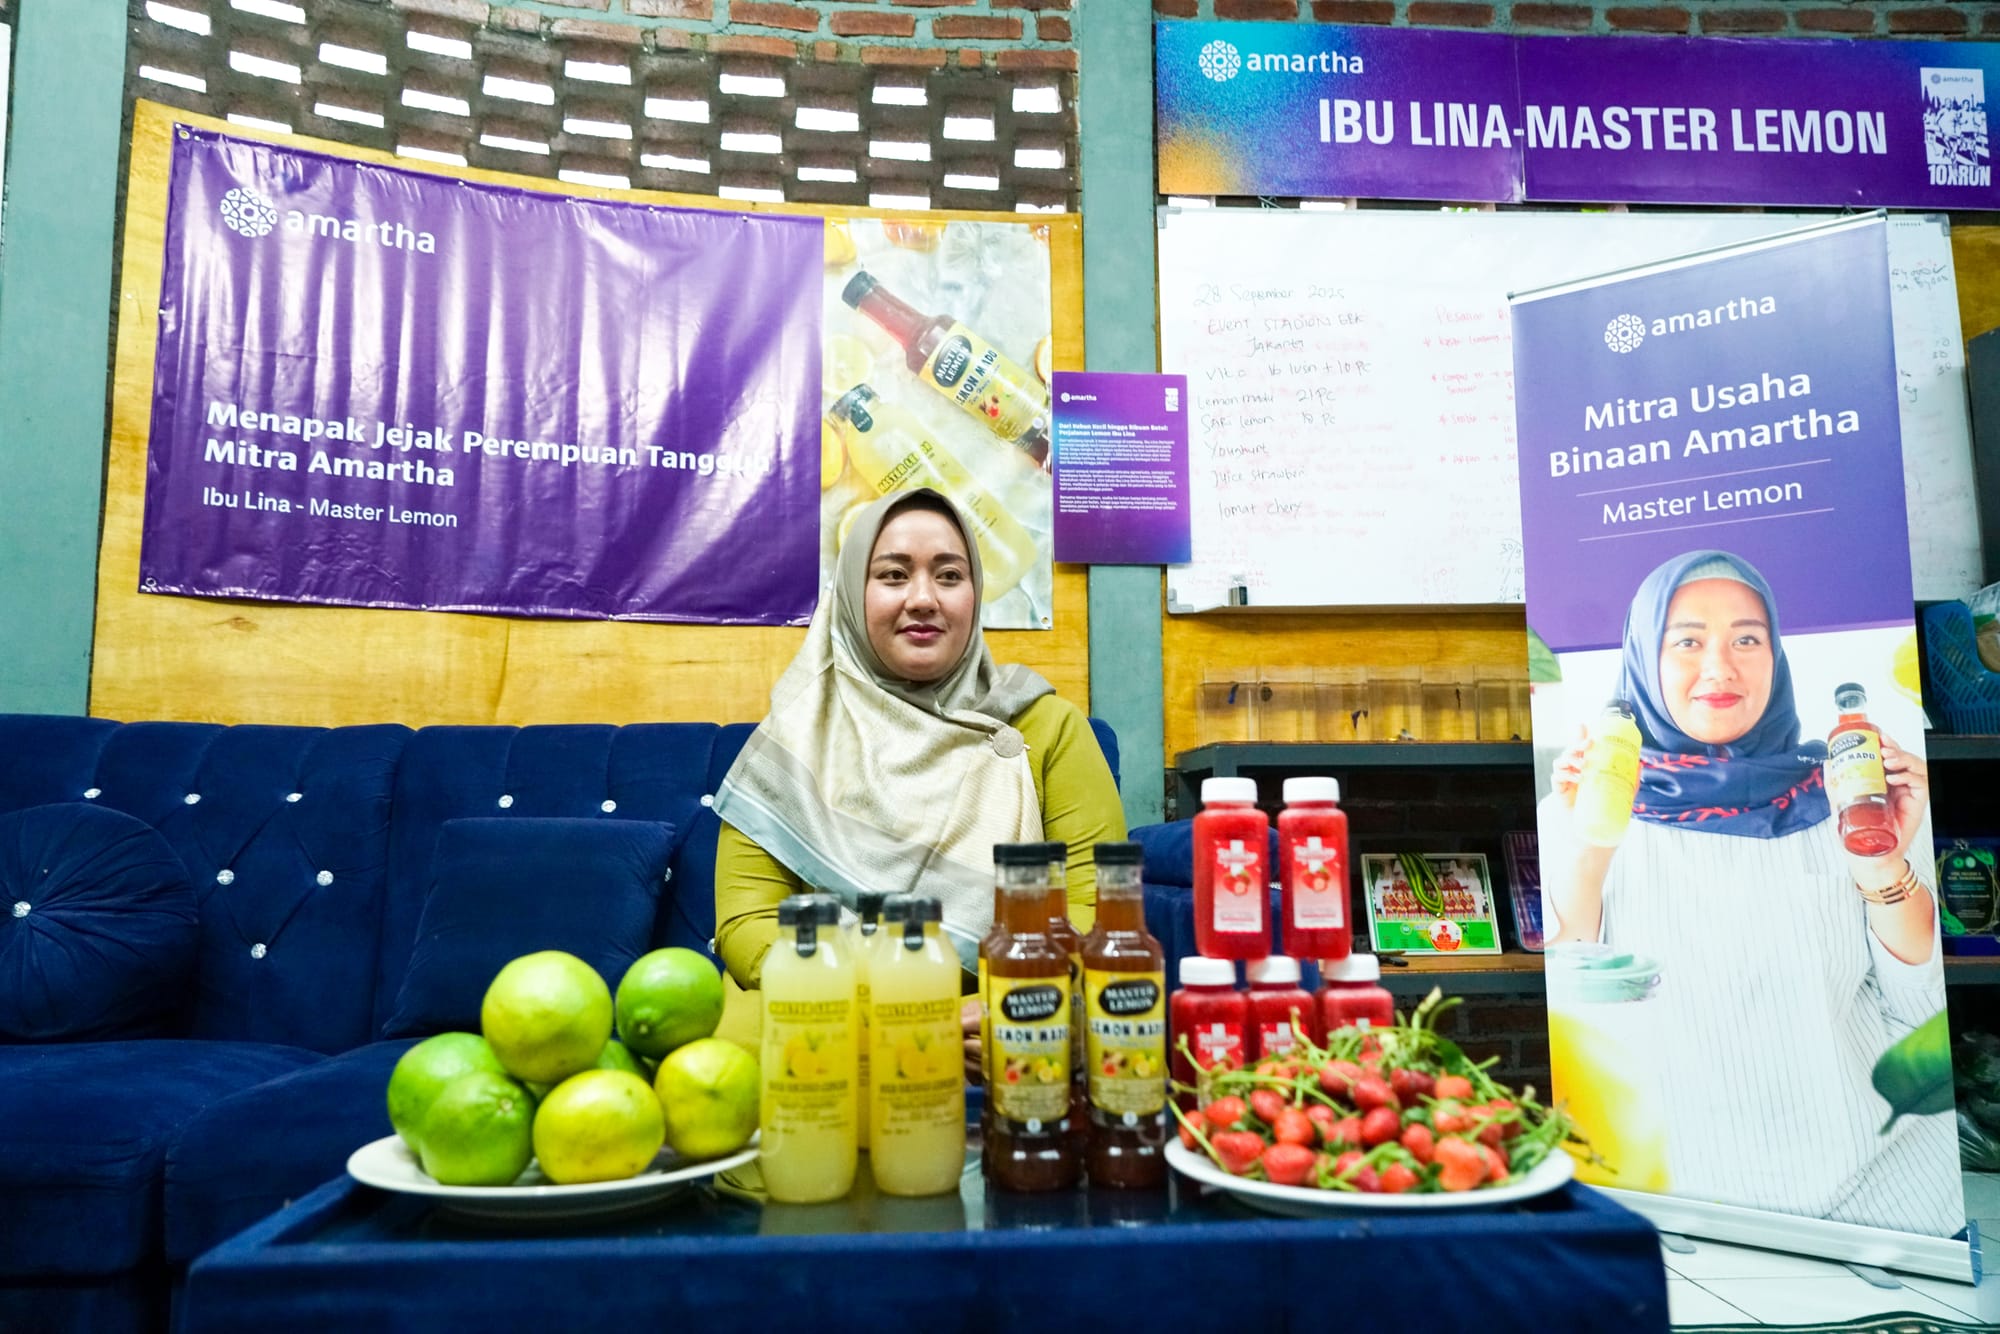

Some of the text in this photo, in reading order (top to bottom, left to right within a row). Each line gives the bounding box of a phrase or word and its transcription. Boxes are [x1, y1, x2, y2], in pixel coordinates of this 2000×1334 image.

[1247, 51, 1364, 74] amartha
[1319, 98, 1395, 145] IBU
[1730, 108, 1888, 155] LEMON
[286, 210, 435, 254] amartha
[1651, 296, 1776, 336] amartha
[1584, 372, 1811, 432] Mitra Usaha
[207, 401, 365, 442] Menapak
[371, 422, 453, 452] Jejak
[463, 431, 639, 467] Perempuan
[1550, 409, 1860, 478] Binaan Amartha
[204, 438, 455, 487] Mitra Amartha
[203, 487, 238, 508] Ibu
[245, 491, 291, 513] Lina
[310, 498, 384, 522] Master
[389, 505, 458, 528] Lemon
[1603, 481, 1803, 525] Master Lemon
